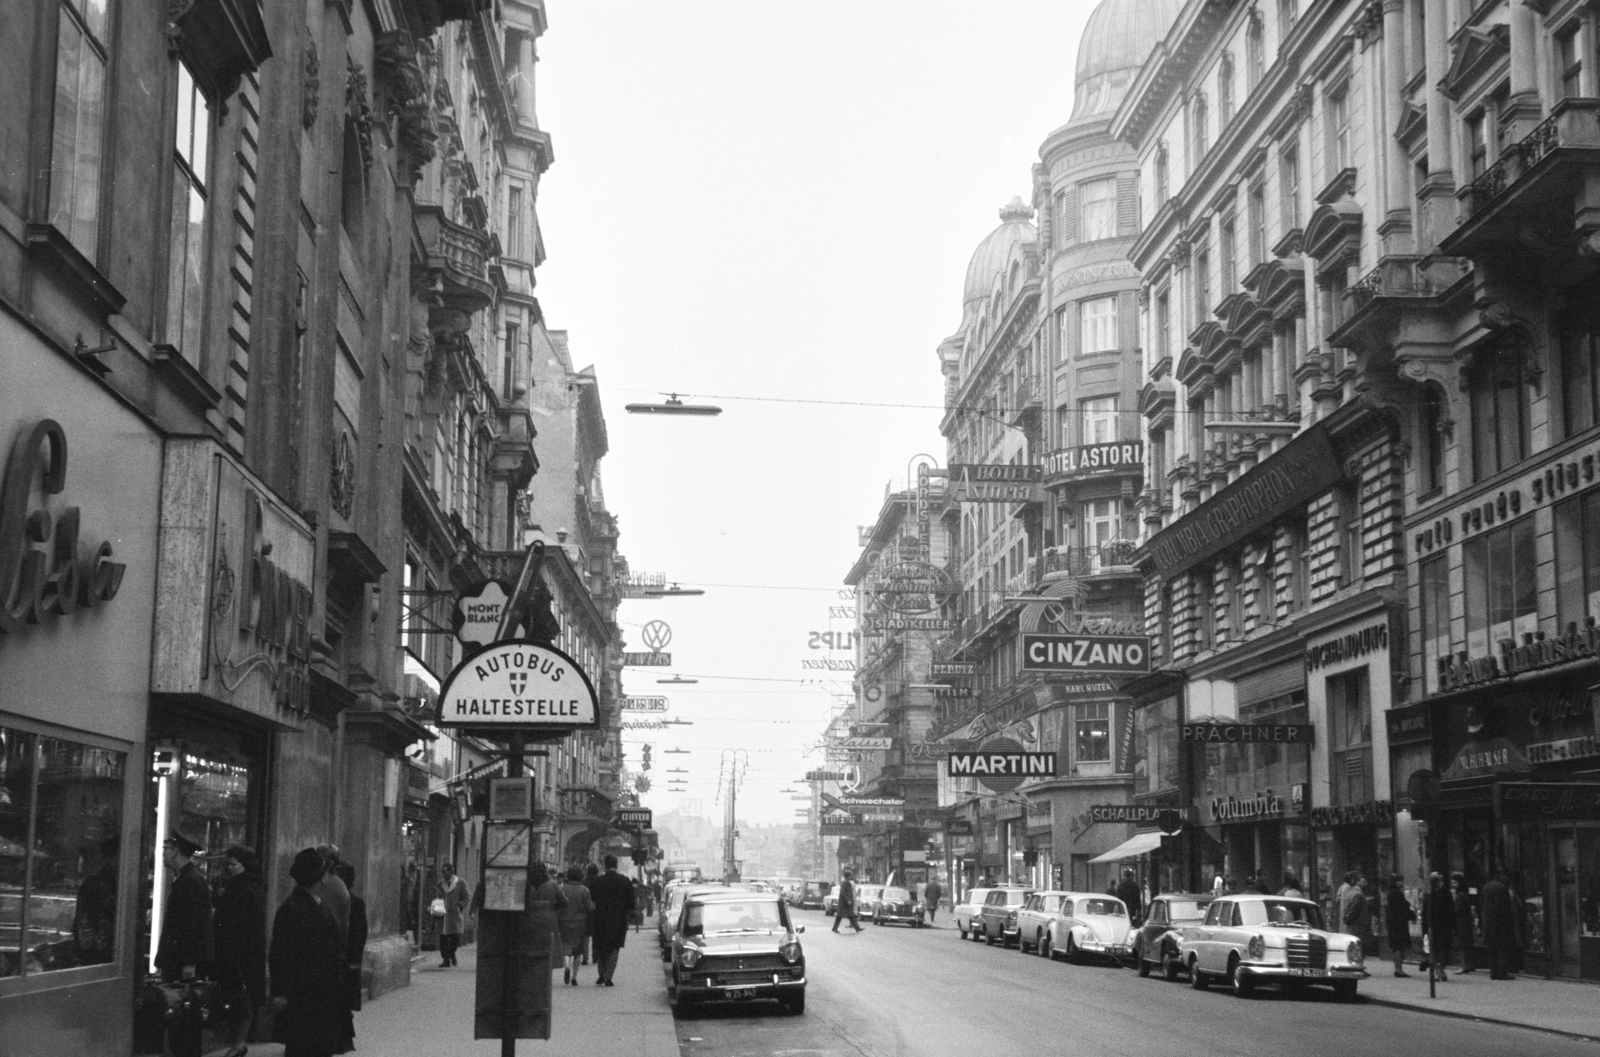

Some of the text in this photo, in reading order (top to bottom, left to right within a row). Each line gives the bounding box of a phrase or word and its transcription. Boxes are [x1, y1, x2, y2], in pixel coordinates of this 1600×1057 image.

[977, 466, 1032, 480] HOTEL
[956, 467, 1030, 499] Astoria
[1155, 519, 1210, 570] COLUMBIA
[468, 604, 501, 613] MONT
[467, 614, 500, 623] BLANC
[875, 619, 951, 629] STADTKELLER
[1029, 640, 1143, 666] CINZANO
[474, 652, 565, 682] AUTOBUS
[456, 699, 579, 716] HALTESTELLE
[1182, 726, 1299, 741] PRACHNER
[951, 754, 1054, 774] MARTINI
[839, 797, 905, 806] Schwechater
[1210, 789, 1281, 821] Columbia
[1093, 808, 1188, 821] SCHALLPLAN
